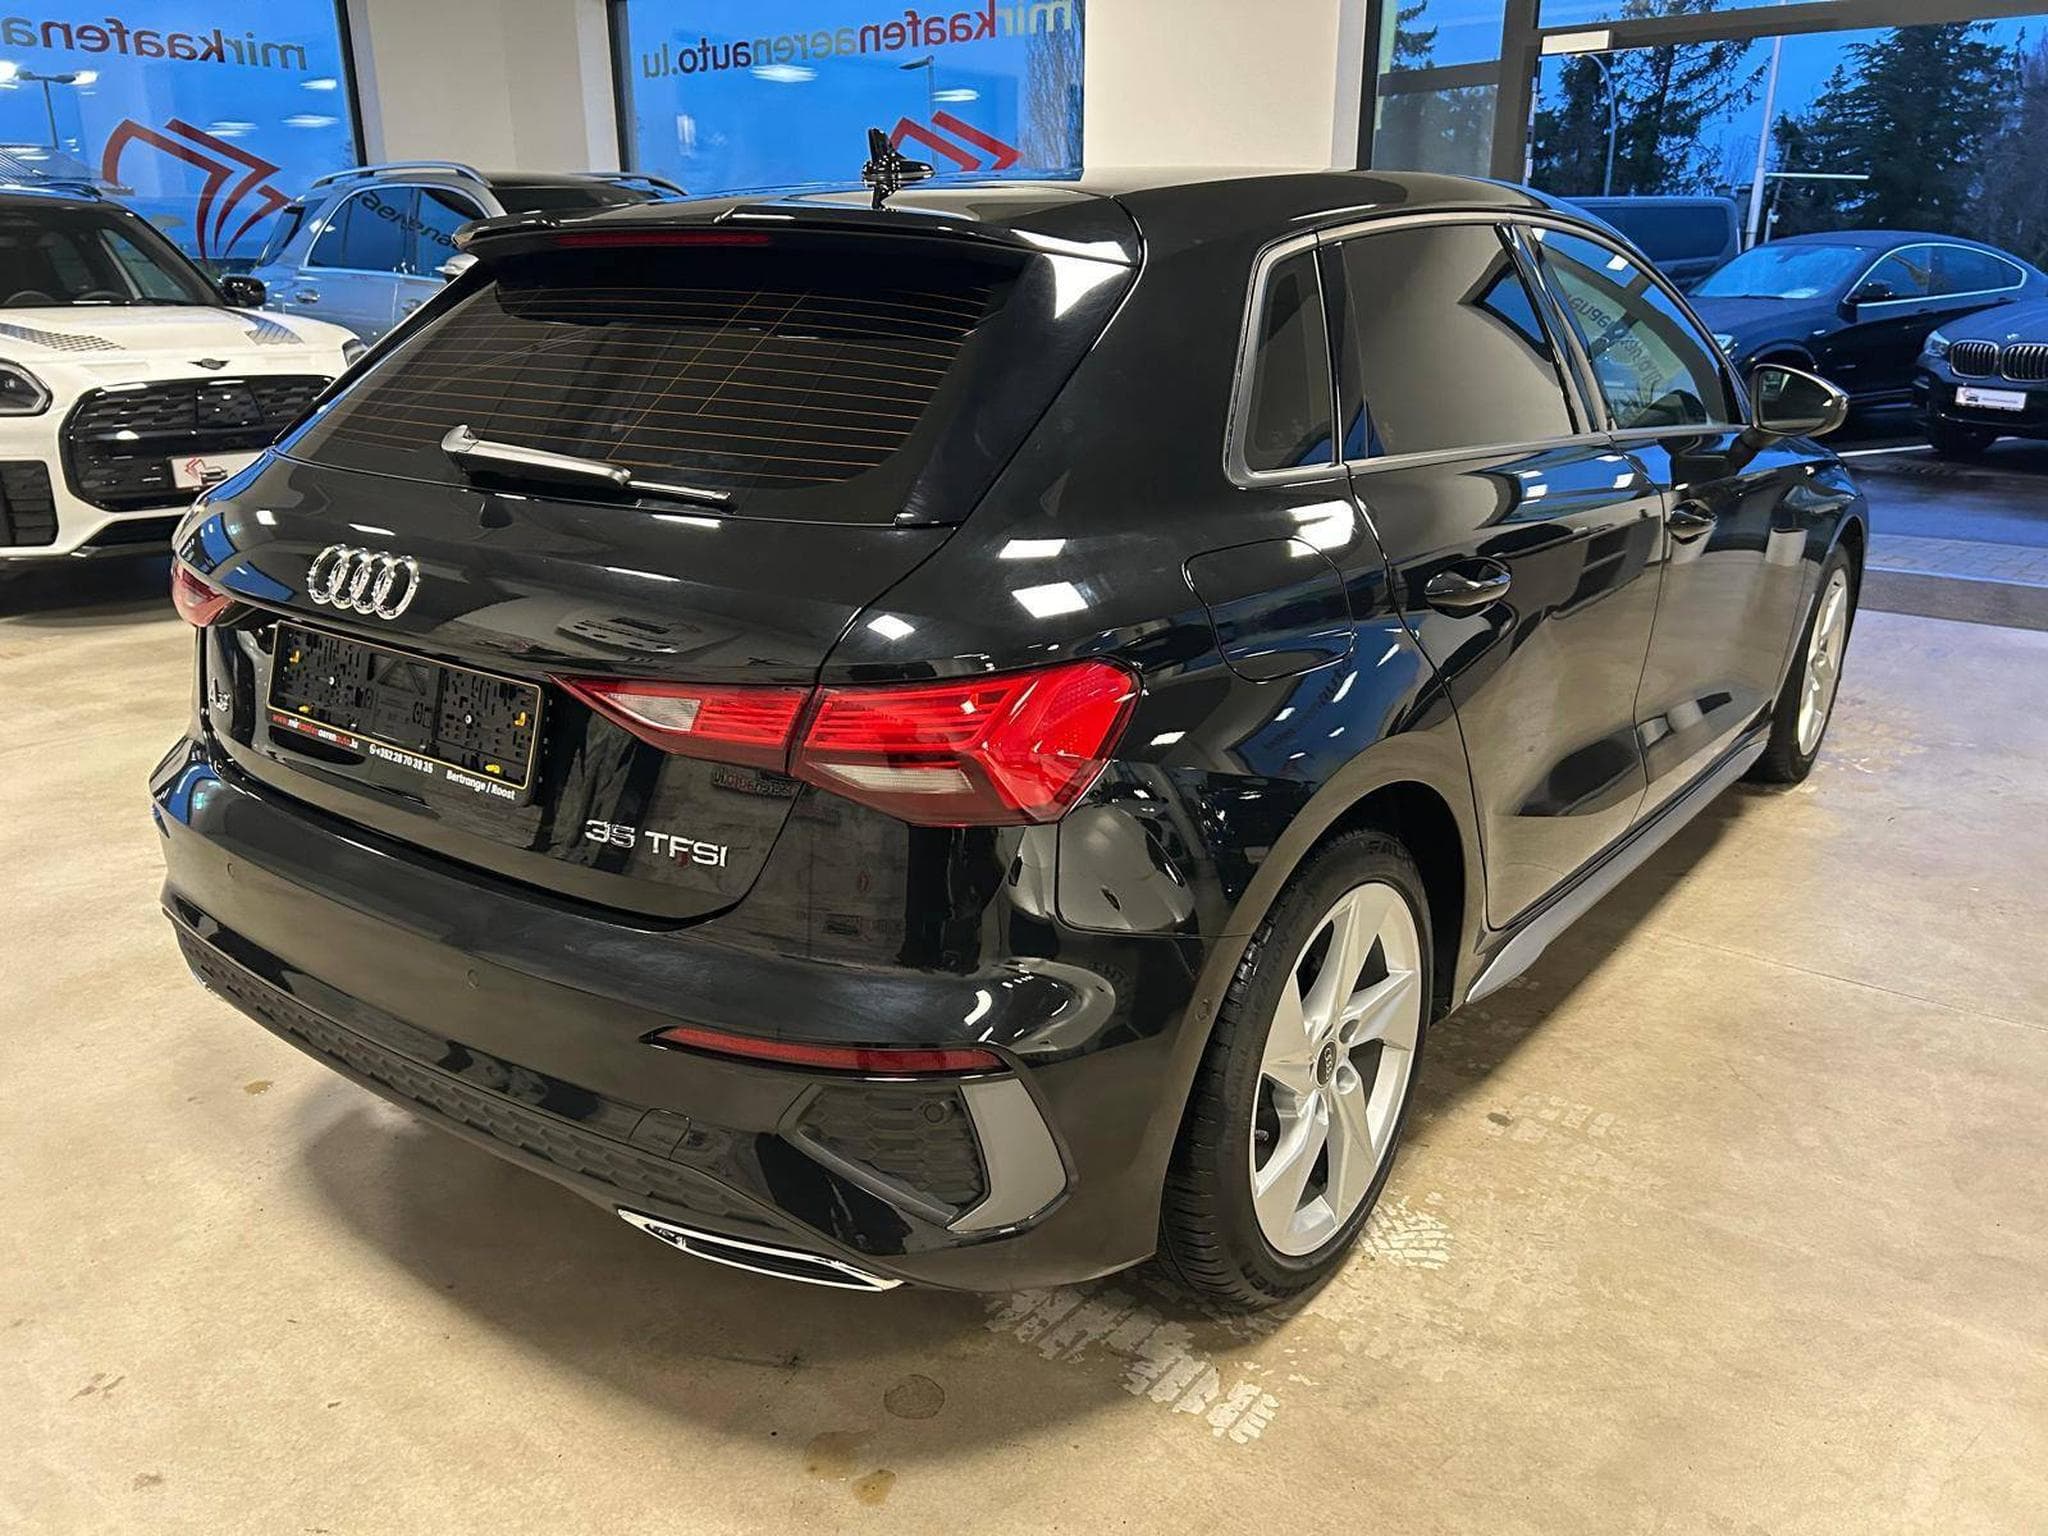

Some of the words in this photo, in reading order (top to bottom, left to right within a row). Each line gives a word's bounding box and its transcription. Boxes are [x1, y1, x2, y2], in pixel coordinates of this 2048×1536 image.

[446, 769, 486, 793] Bertrange
[584, 819, 636, 849] 35
[644, 831, 728, 867] TFSI
